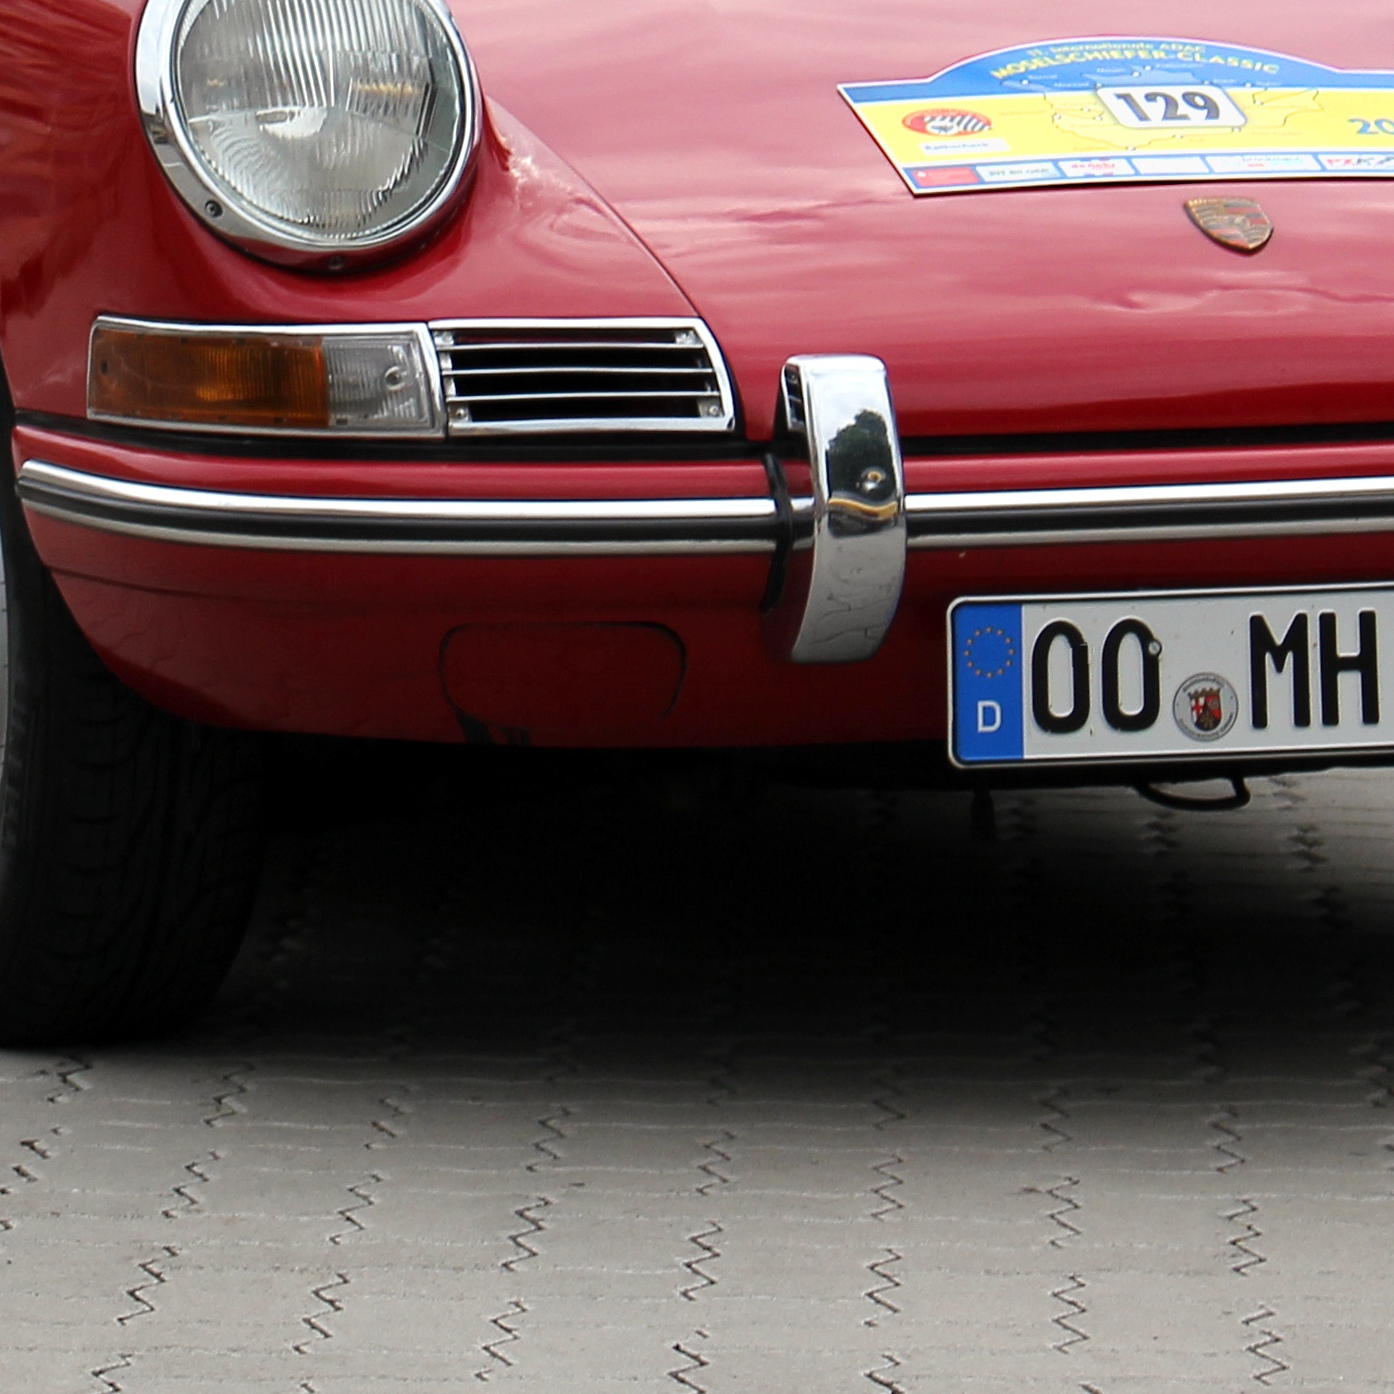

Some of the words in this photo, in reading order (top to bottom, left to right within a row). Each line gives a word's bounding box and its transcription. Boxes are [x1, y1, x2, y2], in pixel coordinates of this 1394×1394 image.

[1114, 90, 1221, 122] 129
[1248, 609, 1381, 729] MH
[976, 699, 1002, 733] D
